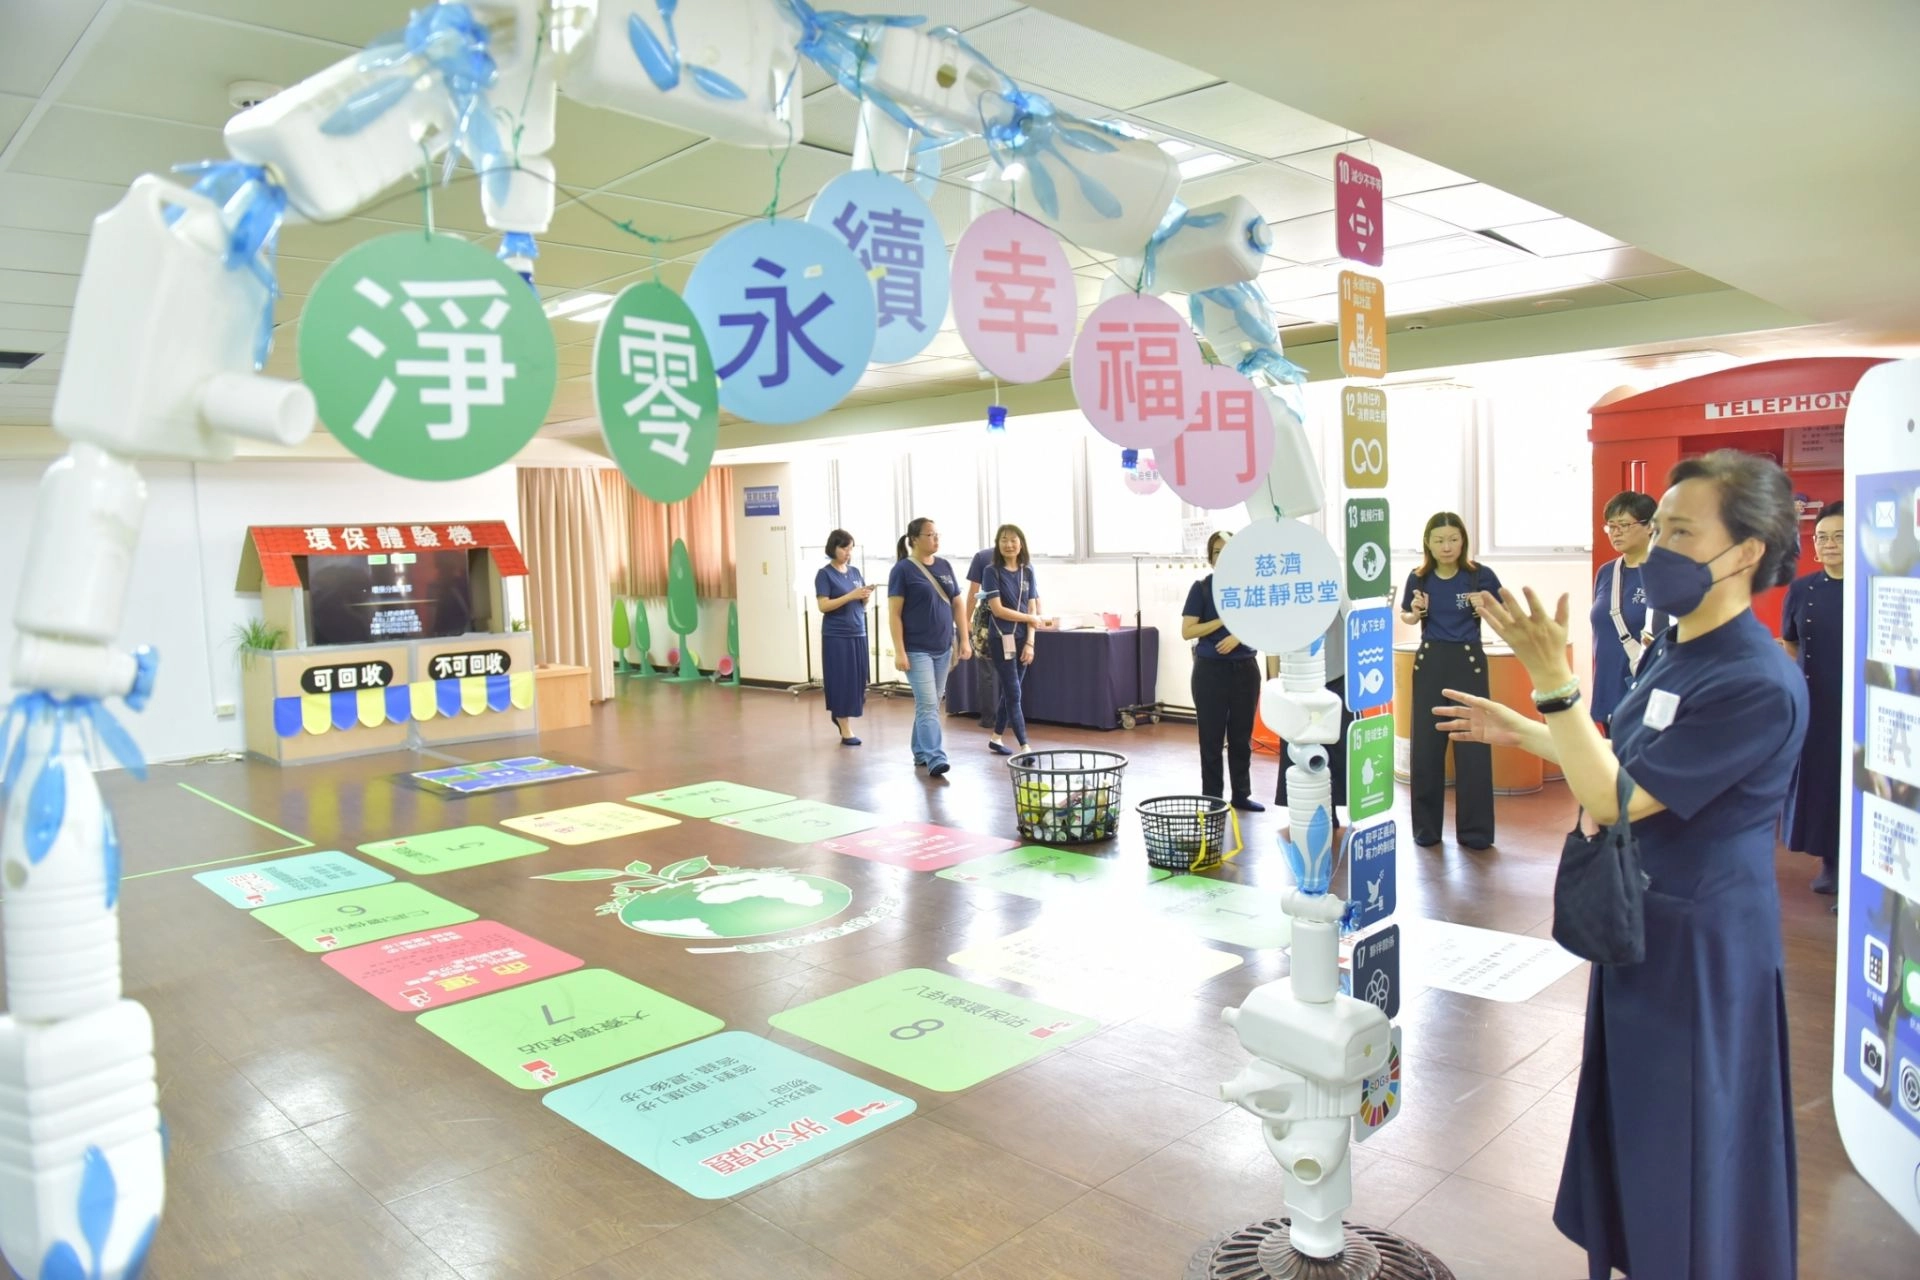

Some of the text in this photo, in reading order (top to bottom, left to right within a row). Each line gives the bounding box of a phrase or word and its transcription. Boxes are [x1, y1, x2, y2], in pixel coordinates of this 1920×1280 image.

[1339, 160, 1349, 184] 10
[833, 201, 927, 332] 續
[976, 240, 1058, 353] 幸
[1344, 277, 1351, 301] 11
[716, 257, 844, 389] 永
[348, 277, 517, 442] 淨
[1096, 321, 1186, 422] 福
[619, 314, 702, 466] 零
[1346, 392, 1355, 416] 12
[1174, 388, 1256, 486] 門
[1348, 505, 1358, 528] 13
[303, 525, 478, 551] 環保體驗機
[1254, 551, 1302, 577] 慈濟
[1219, 579, 1339, 610] 高雄靜思堂
[1350, 617, 1360, 640] 14
[313, 663, 385, 693] 可回收
[434, 652, 504, 679] 不可回收
[1353, 728, 1362, 751] 15
[1354, 837, 1364, 861] 16
[336, 904, 367, 917] 6
[1356, 945, 1366, 969] 17
[540, 1003, 577, 1026] 7
[902, 984, 1030, 1029] 八卦寮環保站
[517, 1009, 651, 1056] 大寮環保站
[888, 1018, 946, 1042] 8
[772, 1077, 809, 1097] 物品
[1370, 1074, 1389, 1094] SDGs
[699, 1114, 830, 1176] 狀況題
